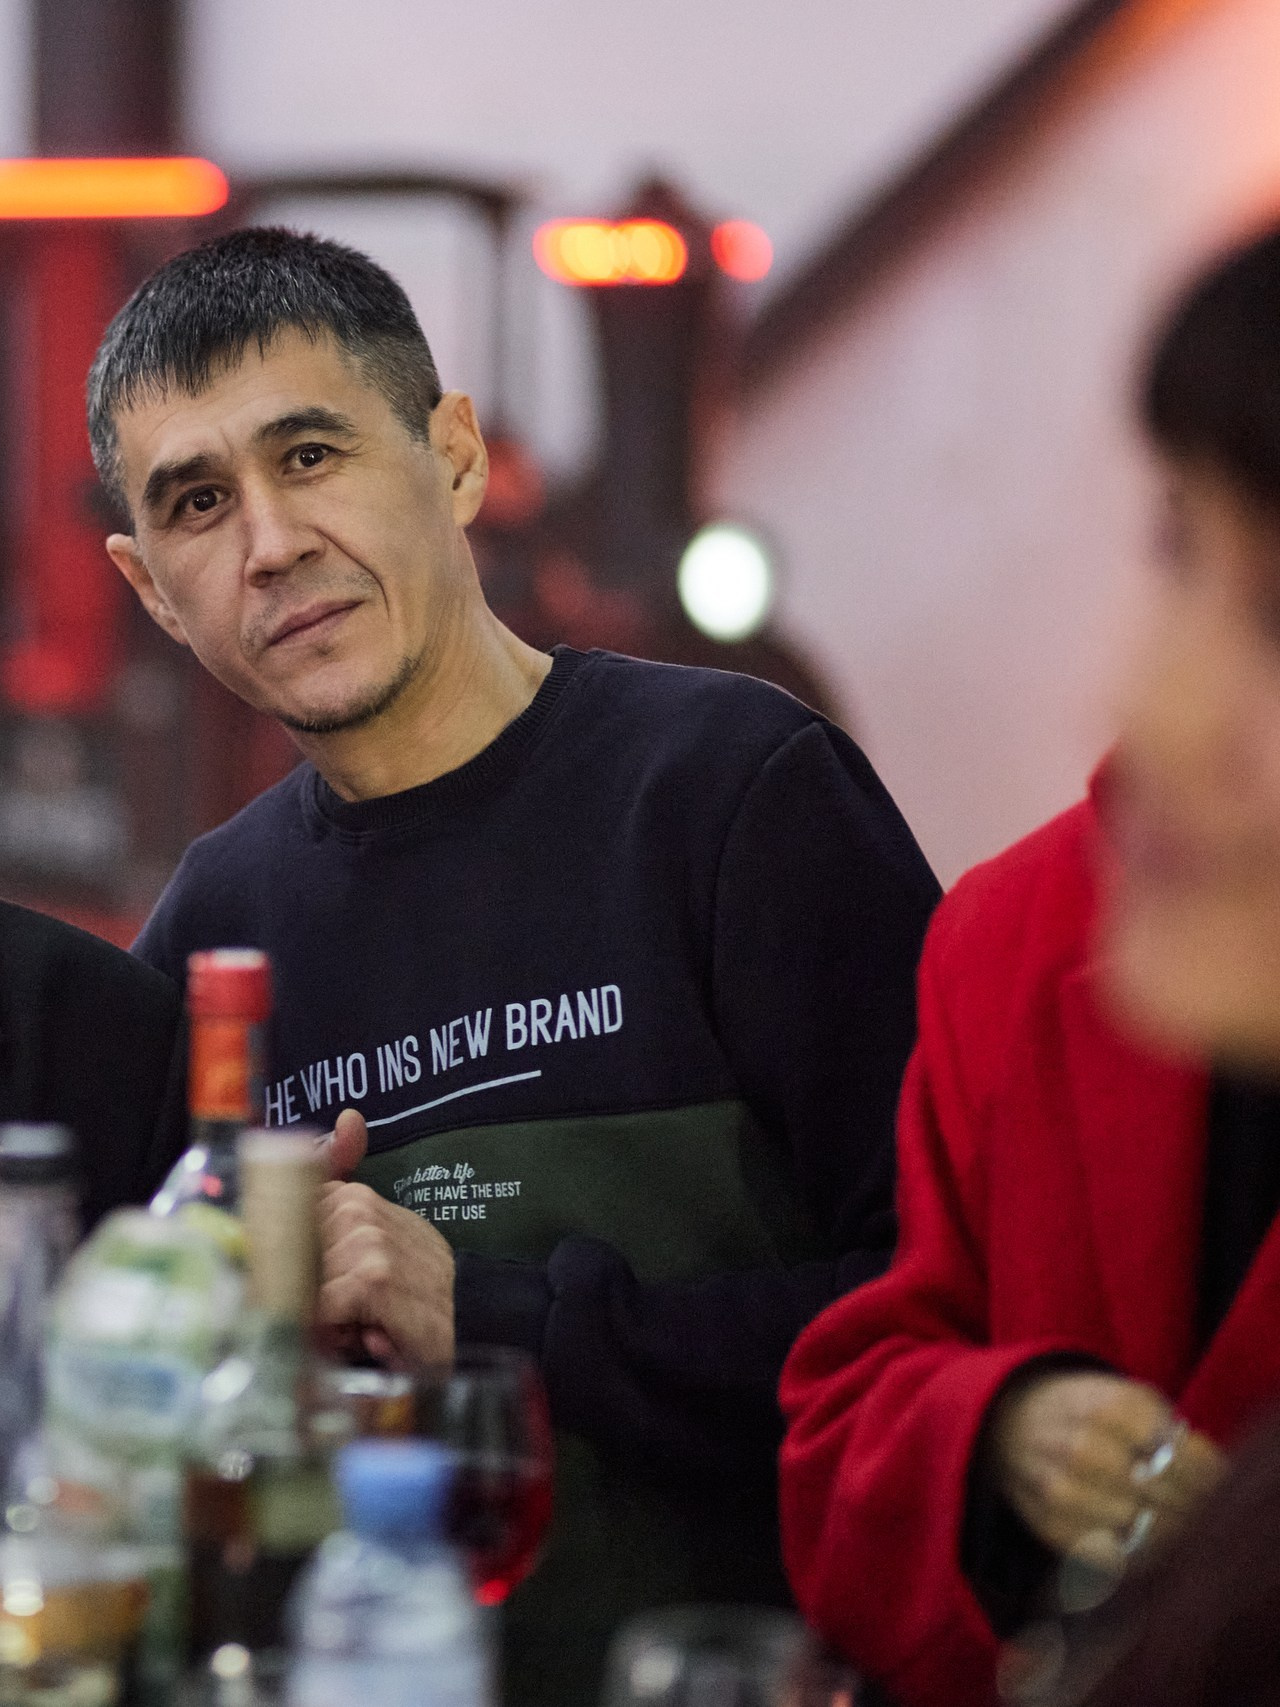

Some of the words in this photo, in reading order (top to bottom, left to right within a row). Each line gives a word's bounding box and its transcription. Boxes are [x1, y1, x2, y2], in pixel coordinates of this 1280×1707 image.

[300, 1052, 368, 1113] WHO
[377, 1034, 422, 1093] INS
[429, 1007, 493, 1076] NEW
[505, 984, 623, 1051] BRAND
[413, 1165, 451, 1183] better
[453, 1163, 475, 1184] life
[414, 1187, 431, 1203] WE
[434, 1185, 469, 1201] HAVE
[470, 1182, 493, 1199] THE
[494, 1181, 522, 1198] BEST
[433, 1205, 459, 1221] LET
[461, 1204, 487, 1221] USE
